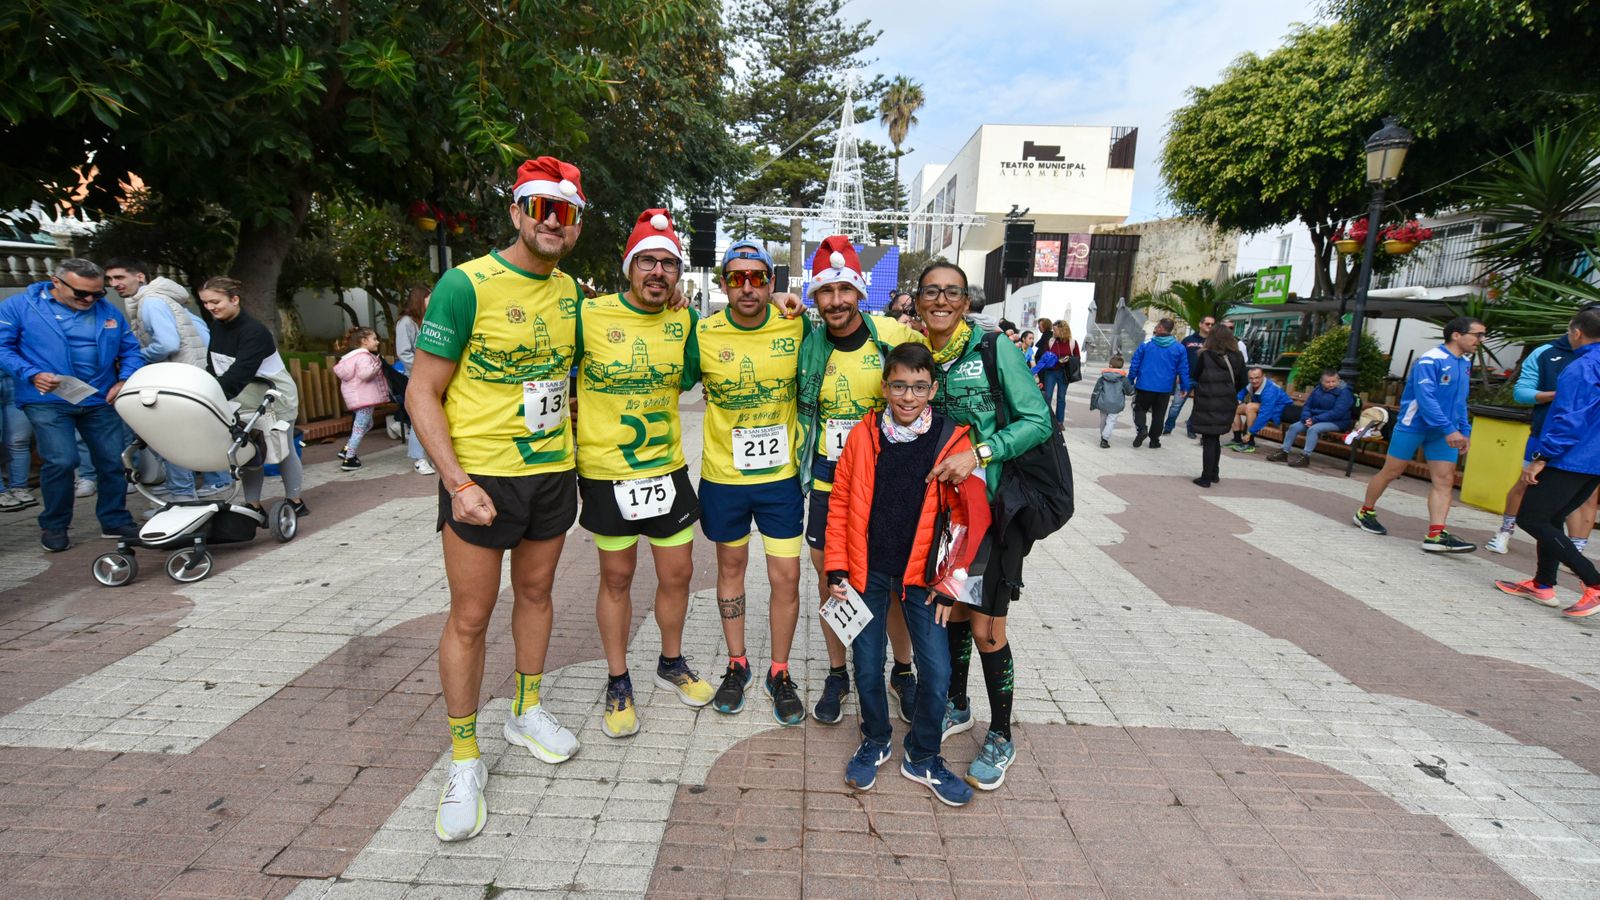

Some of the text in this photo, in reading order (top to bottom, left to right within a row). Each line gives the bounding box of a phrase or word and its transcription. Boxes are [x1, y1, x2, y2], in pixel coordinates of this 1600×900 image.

[1000, 161, 1086, 170] TEATRO MUNICIPAL
[1000, 169, 1085, 178] ALAMEDA
[540, 391, 567, 416] 132
[744, 438, 779, 457] 212
[836, 432, 844, 449] 1
[629, 484, 666, 506] 175
[834, 600, 858, 629] 111
